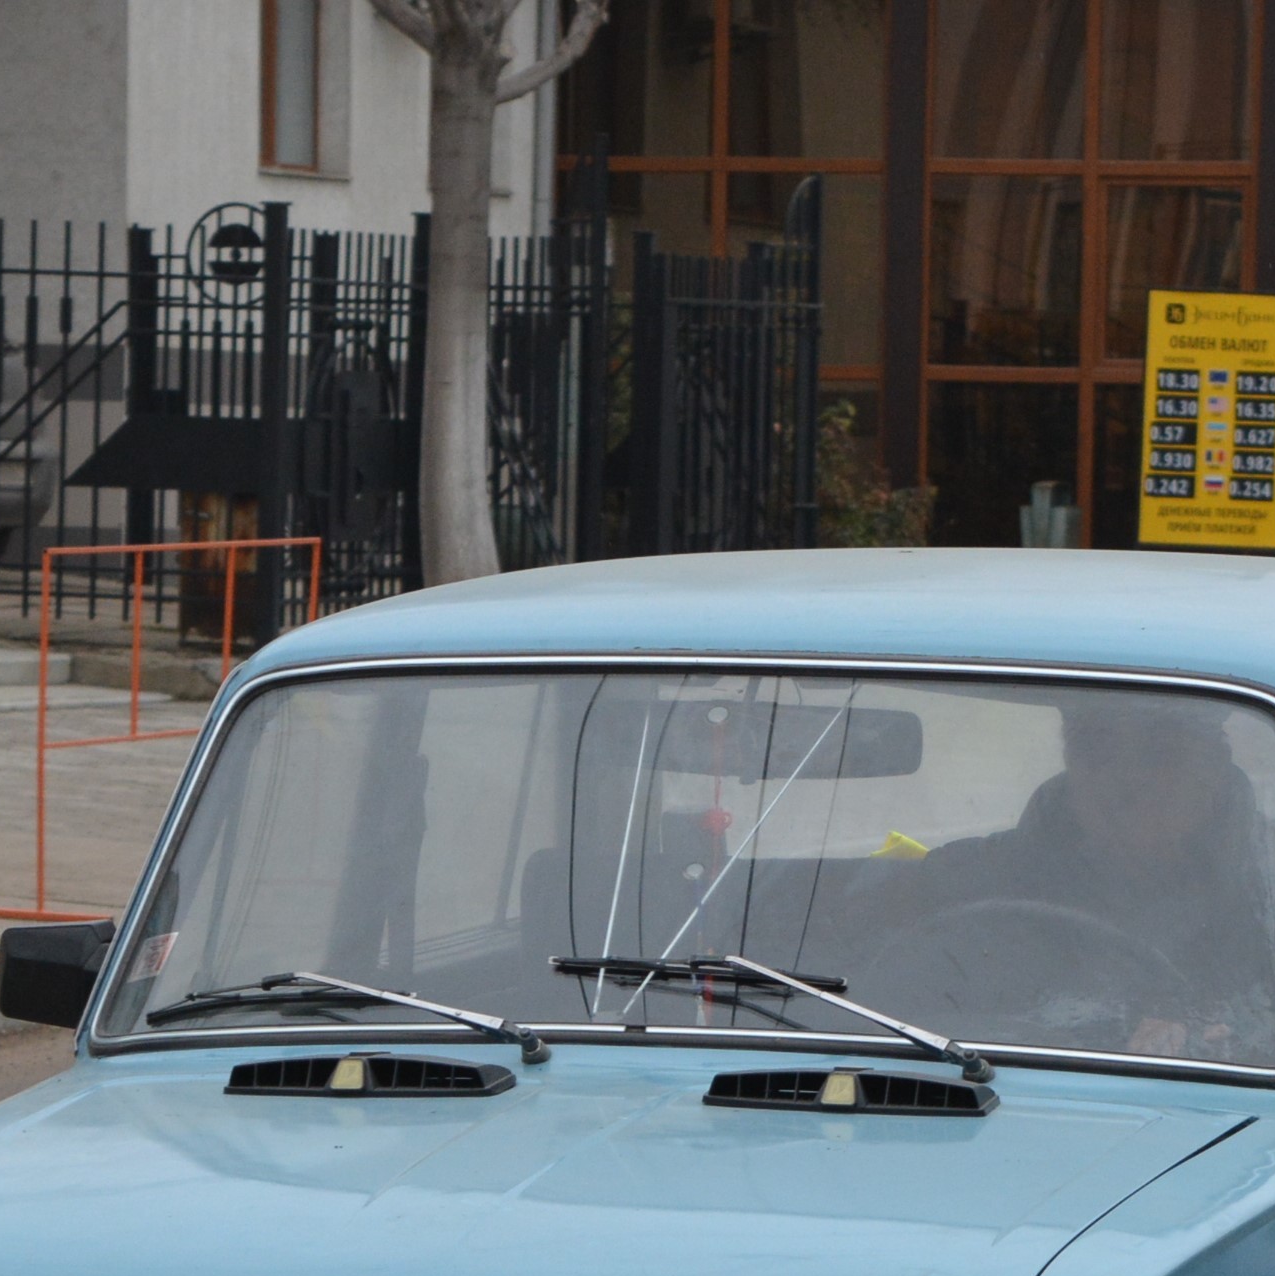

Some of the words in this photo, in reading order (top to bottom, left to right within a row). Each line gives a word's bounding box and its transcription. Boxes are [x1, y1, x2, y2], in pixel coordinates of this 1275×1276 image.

[1170, 335, 1216, 350] ОБМЕН
[1221, 338, 1268, 352] ВАЛЮТ
[1158, 371, 1199, 389] 18.30
[1157, 399, 1197, 415] 16.30
[1237, 402, 1275, 418] 16.35
[1151, 425, 1183, 441] 0.57
[1234, 429, 1275, 444] 0.627
[1150, 451, 1193, 469] 0.930
[1233, 455, 1274, 472] 0.982
[1145, 478, 1188, 495] 0.242
[1229, 481, 1272, 498] 0.254
